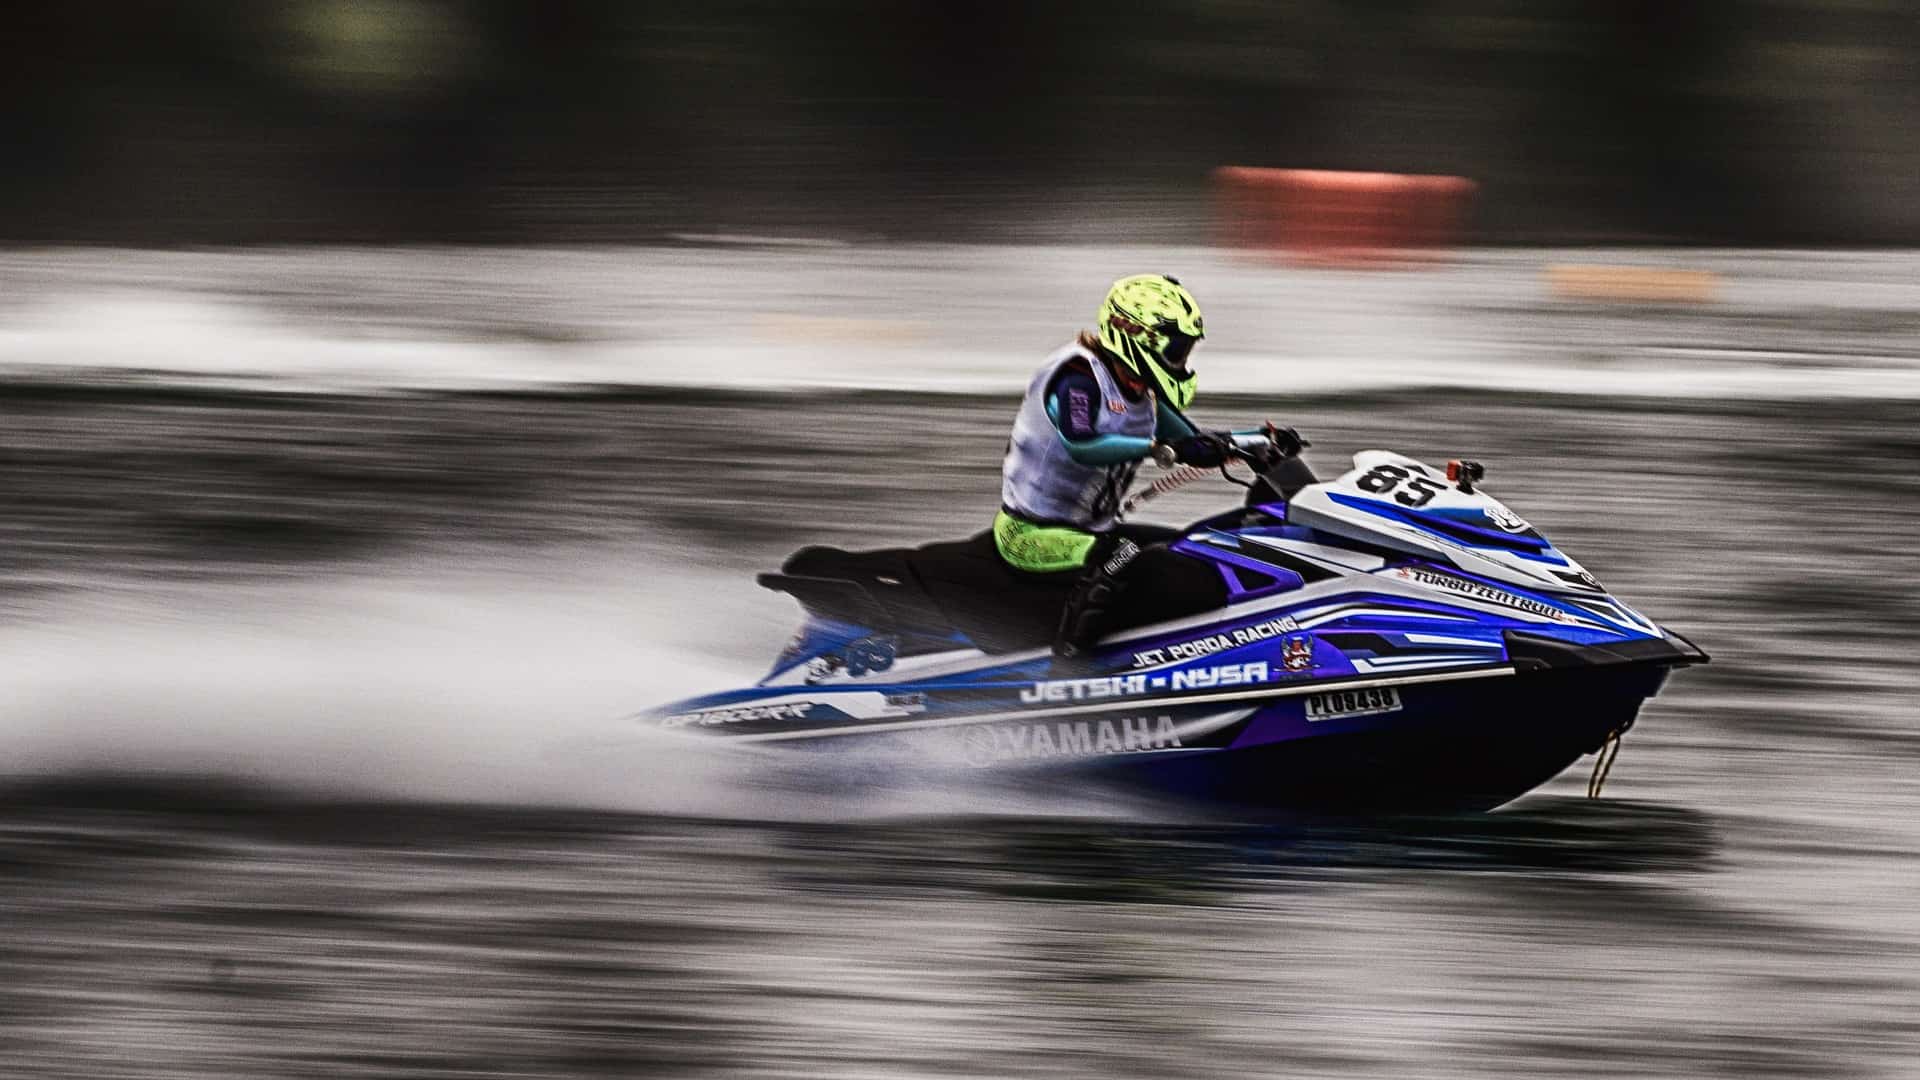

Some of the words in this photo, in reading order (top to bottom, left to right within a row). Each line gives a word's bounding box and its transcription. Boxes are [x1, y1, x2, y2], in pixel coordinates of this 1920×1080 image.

[1356, 464, 1448, 508] 85
[1414, 571, 1474, 593] TURBO
[1133, 649, 1167, 668] JET
[1171, 661, 1268, 690] NYSA
[998, 715, 1182, 757] YAMAHA
